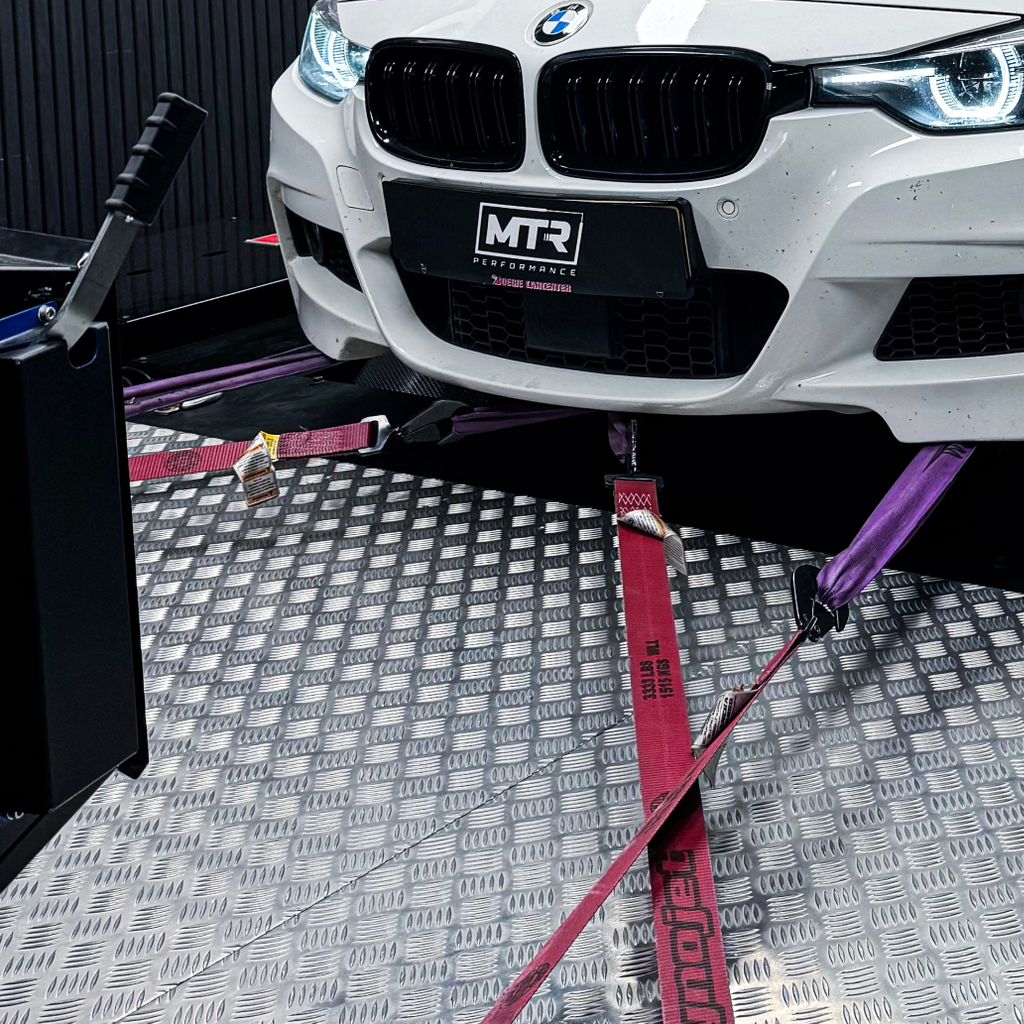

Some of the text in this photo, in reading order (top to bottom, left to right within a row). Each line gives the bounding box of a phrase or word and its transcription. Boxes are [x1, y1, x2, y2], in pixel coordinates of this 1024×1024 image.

[485, 214, 571, 252] MTR
[473, 257, 576, 276] PERFORMANCE
[639, 660, 655, 677] LBS
[656, 659, 672, 677] KGS
